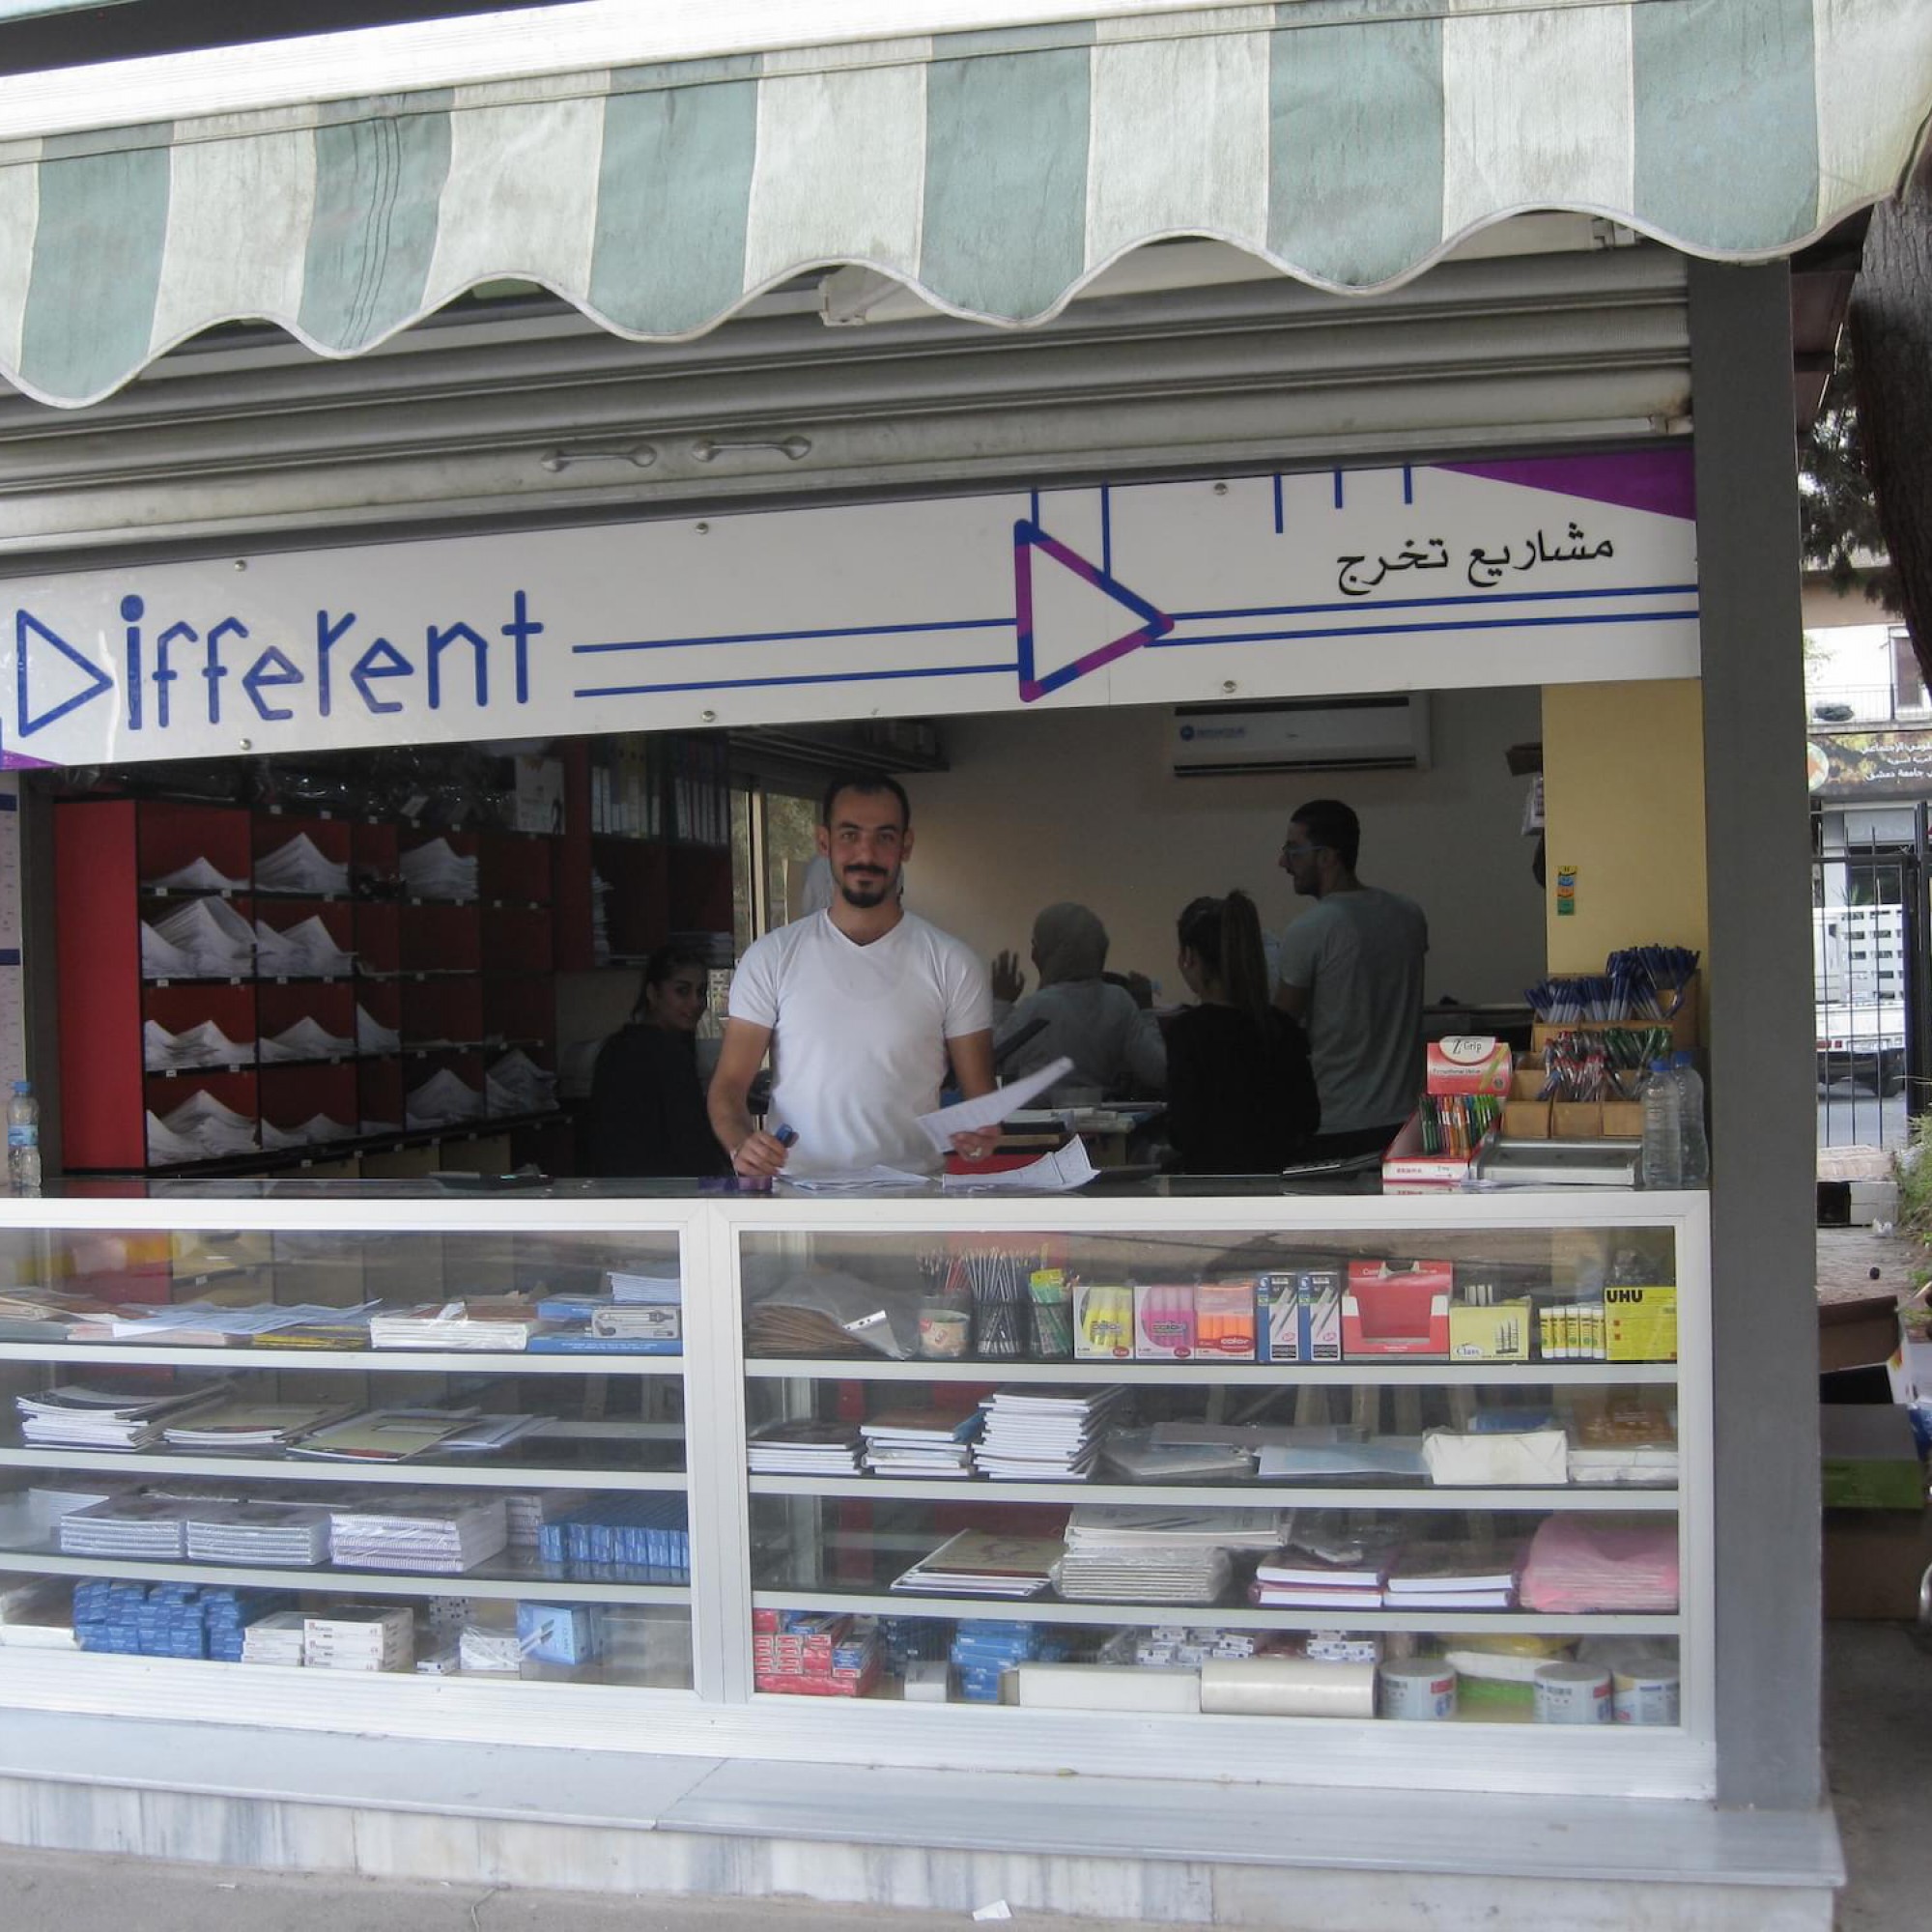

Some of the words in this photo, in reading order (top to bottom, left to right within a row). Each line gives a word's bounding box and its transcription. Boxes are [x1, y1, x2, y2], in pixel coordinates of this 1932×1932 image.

[1337, 538, 1449, 596] تخرج
[1468, 522, 1613, 587] مشاريع
[16, 589, 544, 737] Different
[1606, 1289, 1643, 1303] UHU
